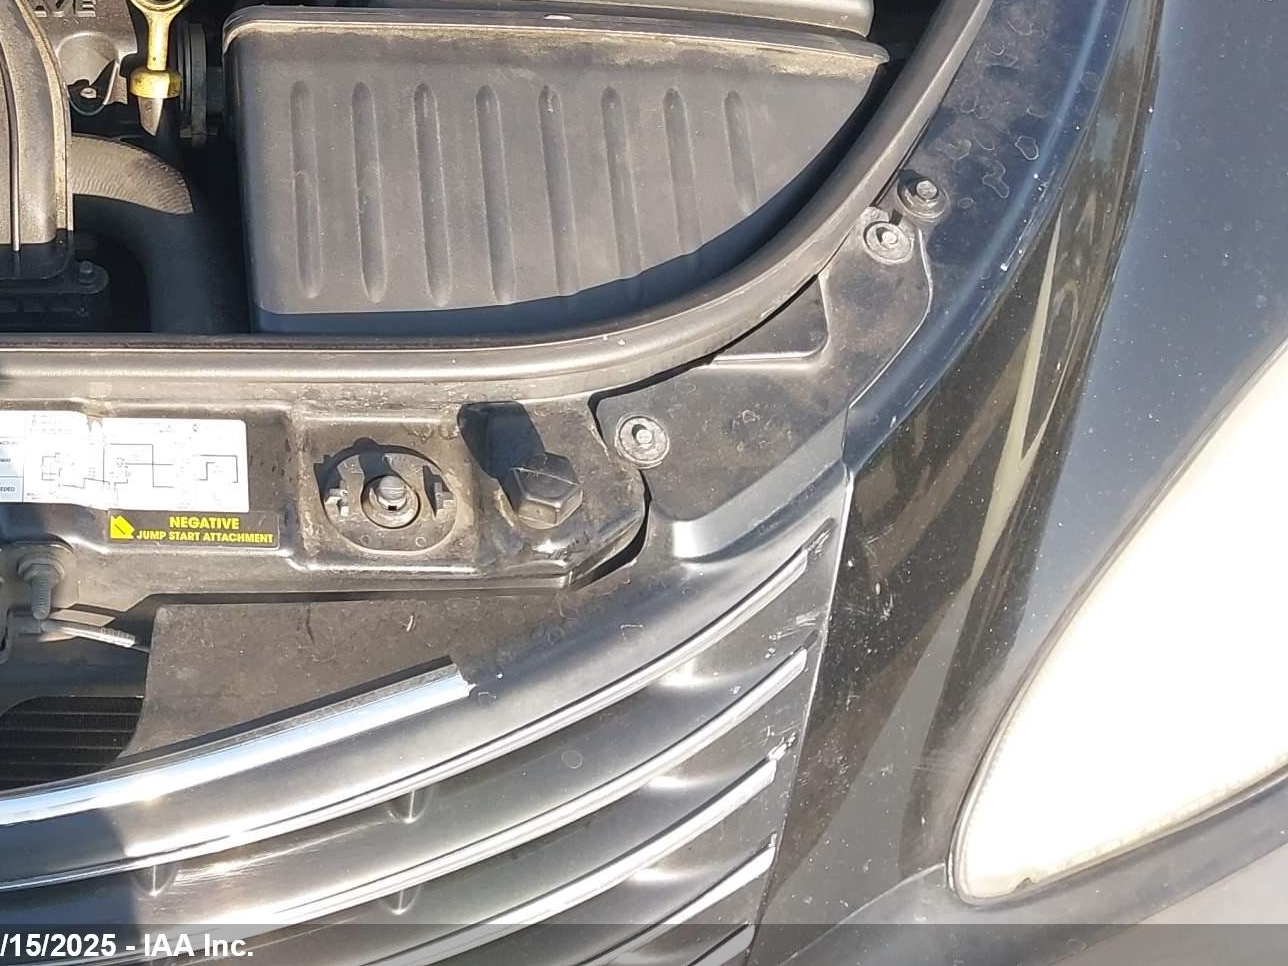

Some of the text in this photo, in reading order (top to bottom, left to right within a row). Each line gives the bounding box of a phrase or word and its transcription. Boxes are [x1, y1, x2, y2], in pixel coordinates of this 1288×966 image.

[169, 516, 241, 530] NEGATIVE
[136, 530, 274, 544] JUMP START ATTACHMENT
